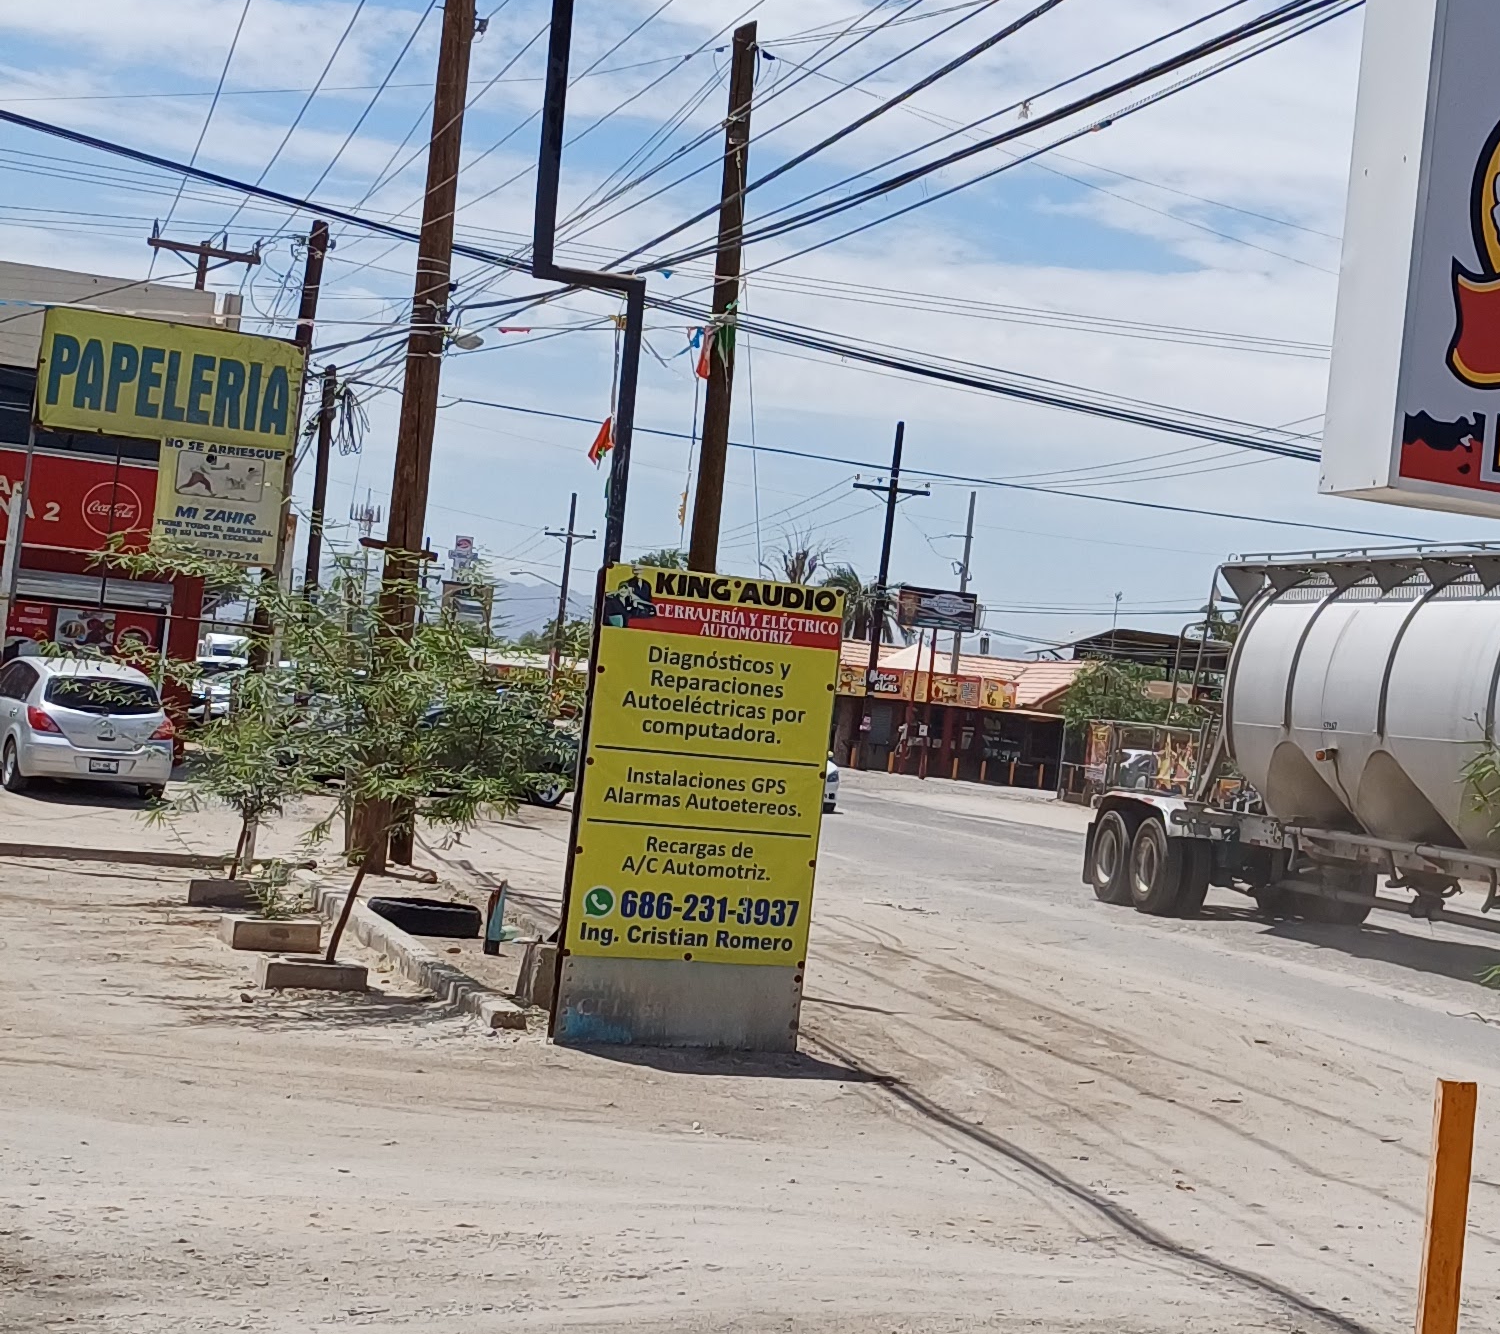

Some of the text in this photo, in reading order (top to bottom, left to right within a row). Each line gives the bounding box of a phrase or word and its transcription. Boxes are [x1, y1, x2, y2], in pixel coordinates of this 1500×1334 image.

[46, 333, 289, 435] PAPELERIA
[188, 441, 204, 451] SE
[208, 444, 285, 460] ARRIESGUE
[43, 501, 60, 522] 2
[175, 505, 256, 525] MI ZAHIR
[655, 572, 838, 612] KING AUDIO
[655, 603, 839, 636] CERRAJERÍA Y ELÉCTRICO
[700, 622, 793, 645] AUTOMOTRIZ
[649, 646, 791, 680] Diagnósticos y
[651, 669, 784, 699] Reparaciones
[622, 690, 806, 725] Autoeléctricas por
[642, 718, 781, 744] computadora.
[626, 767, 787, 795] Instalaciones GPS
[603, 787, 802, 818] Alarmas Autoetereos.
[647, 836, 754, 859] Recargas de
[621, 855, 771, 881] A/C Automotriz.
[620, 890, 800, 927] 686-231-3937
[579, 922, 793, 952] Ing. Cristian Romero
